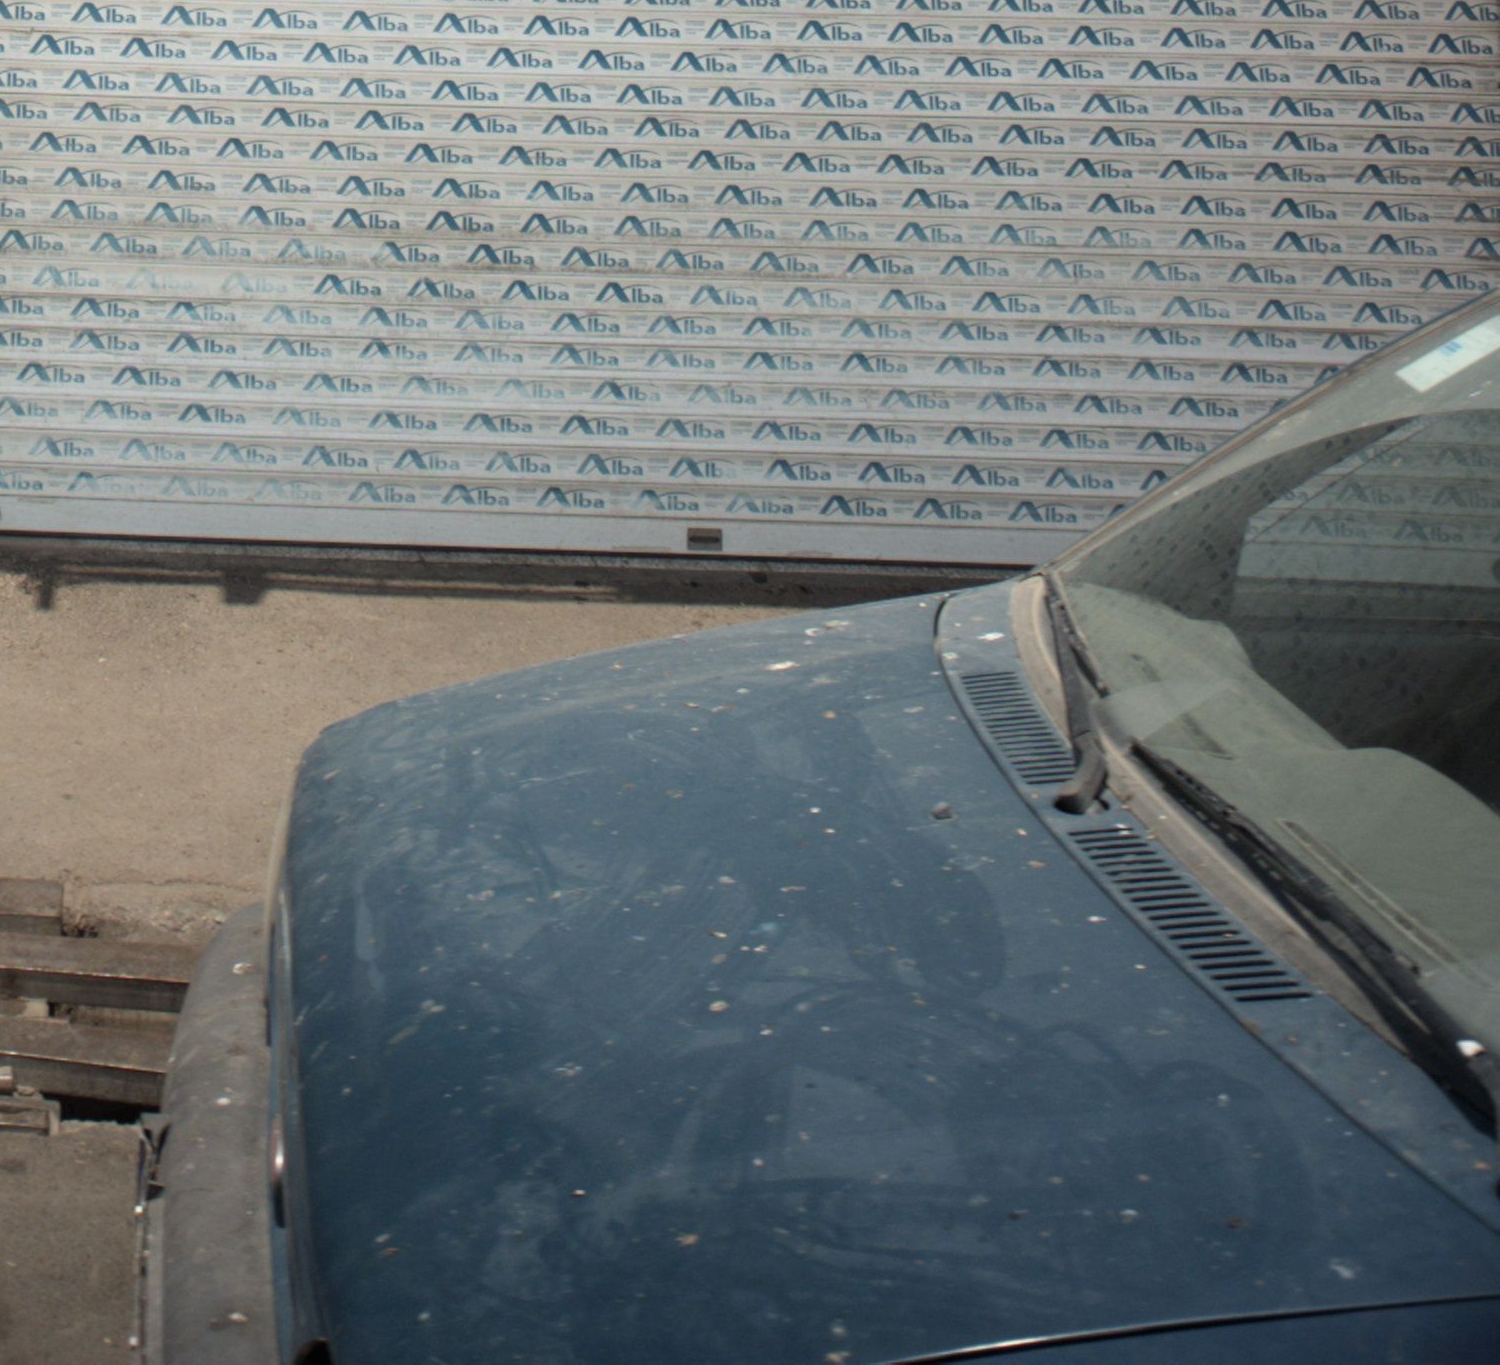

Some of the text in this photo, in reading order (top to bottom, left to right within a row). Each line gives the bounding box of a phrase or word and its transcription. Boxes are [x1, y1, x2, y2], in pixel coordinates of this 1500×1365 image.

[30, 35, 1470, 88] Alba Alba Alba Alba Alba Alba Alba Alba Alba Alba Alba Alba Alba Alba Alba Alba
[50, 200, 1437, 255] Alba Alba Alba Alba Alba Alba Alba Alba Alba Alba Alba Alba Alba Alba Alba
[69, 330, 139, 350] Alba
[168, 333, 234, 353] Alba
[264, 336, 330, 356] Alba
[359, 339, 425, 359] Alba
[455, 342, 521, 362] Alba
[551, 345, 617, 365] Alba
[645, 348, 715, 368] Alba
[743, 350, 813, 370] Alba
[840, 352, 906, 372] Alba
[935, 355, 1005, 375] Alba
[1032, 357, 1098, 377] Alba
[1127, 360, 1193, 380] Alba
[1220, 363, 1286, 383] Alba
[29, 435, 1111, 488] Alba Alba Alba Alba Alba Alba Alba Alba Alba Alba Alba
